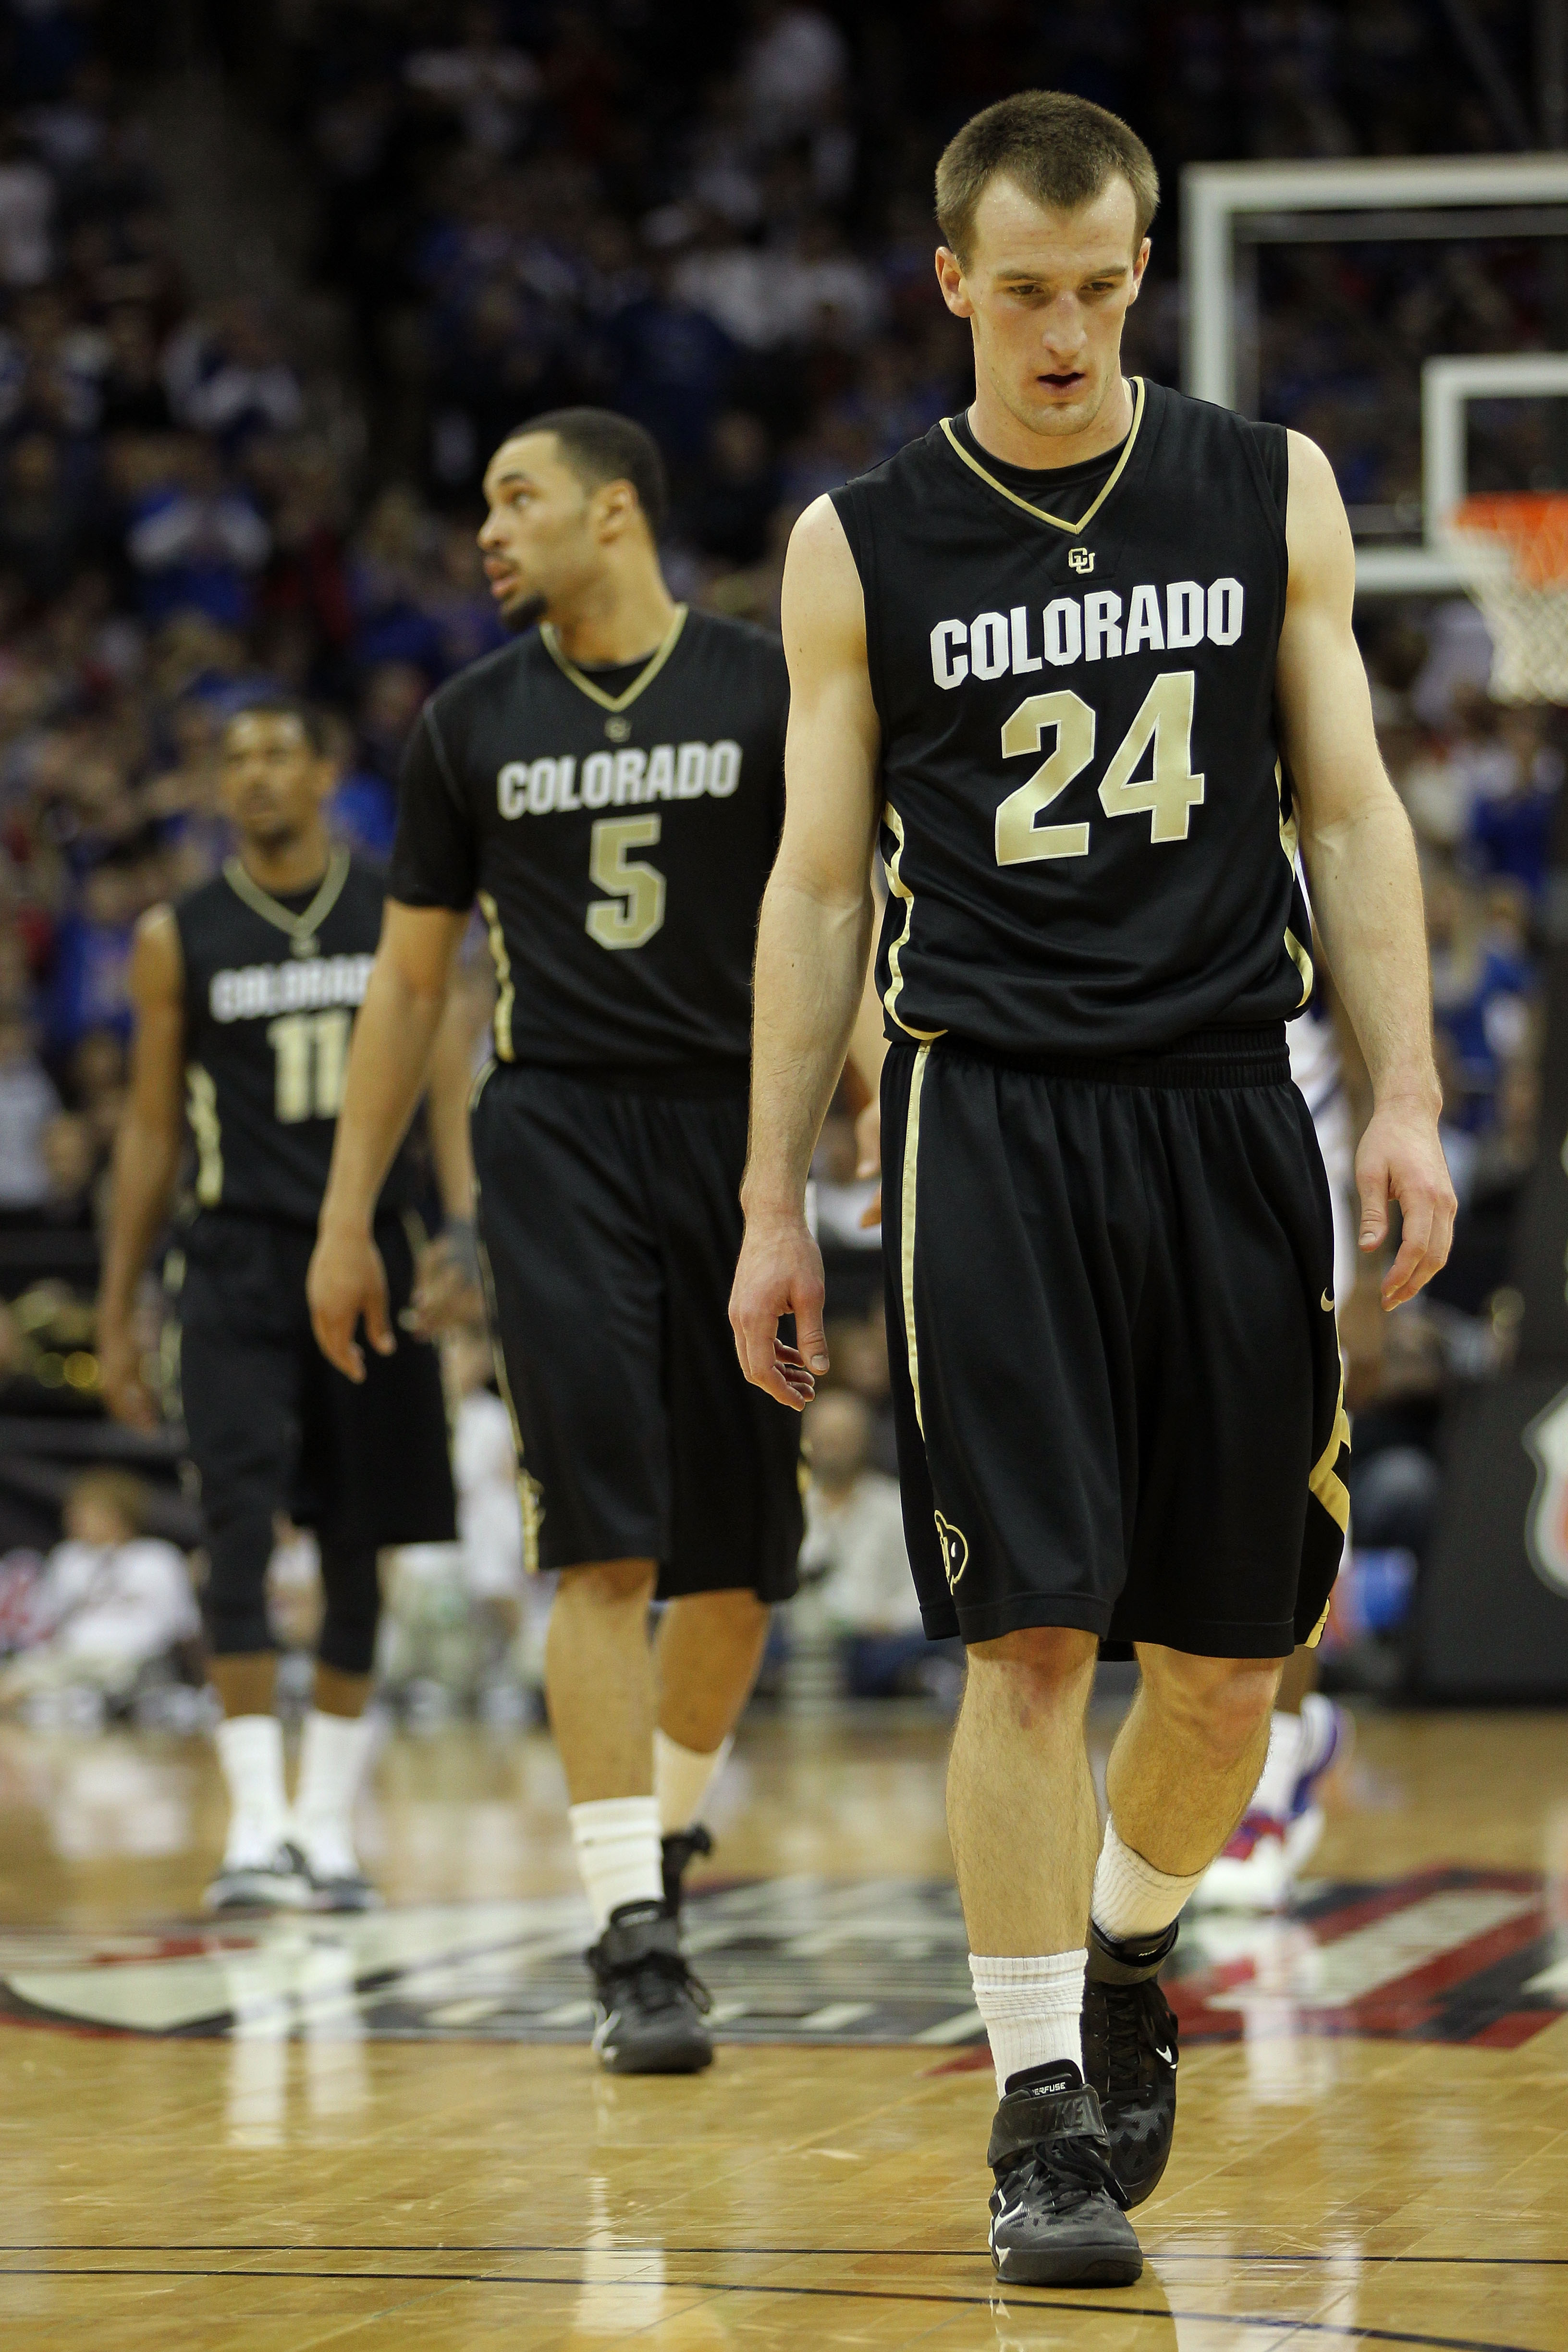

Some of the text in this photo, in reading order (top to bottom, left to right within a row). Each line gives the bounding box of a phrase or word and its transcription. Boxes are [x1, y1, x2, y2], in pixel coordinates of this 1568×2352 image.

[930, 578, 1243, 690] COLORADO
[497, 740, 742, 820] COLORADO
[995, 671, 1204, 867] 24
[585, 813, 667, 950] 5
[267, 1007, 353, 1123] 11
